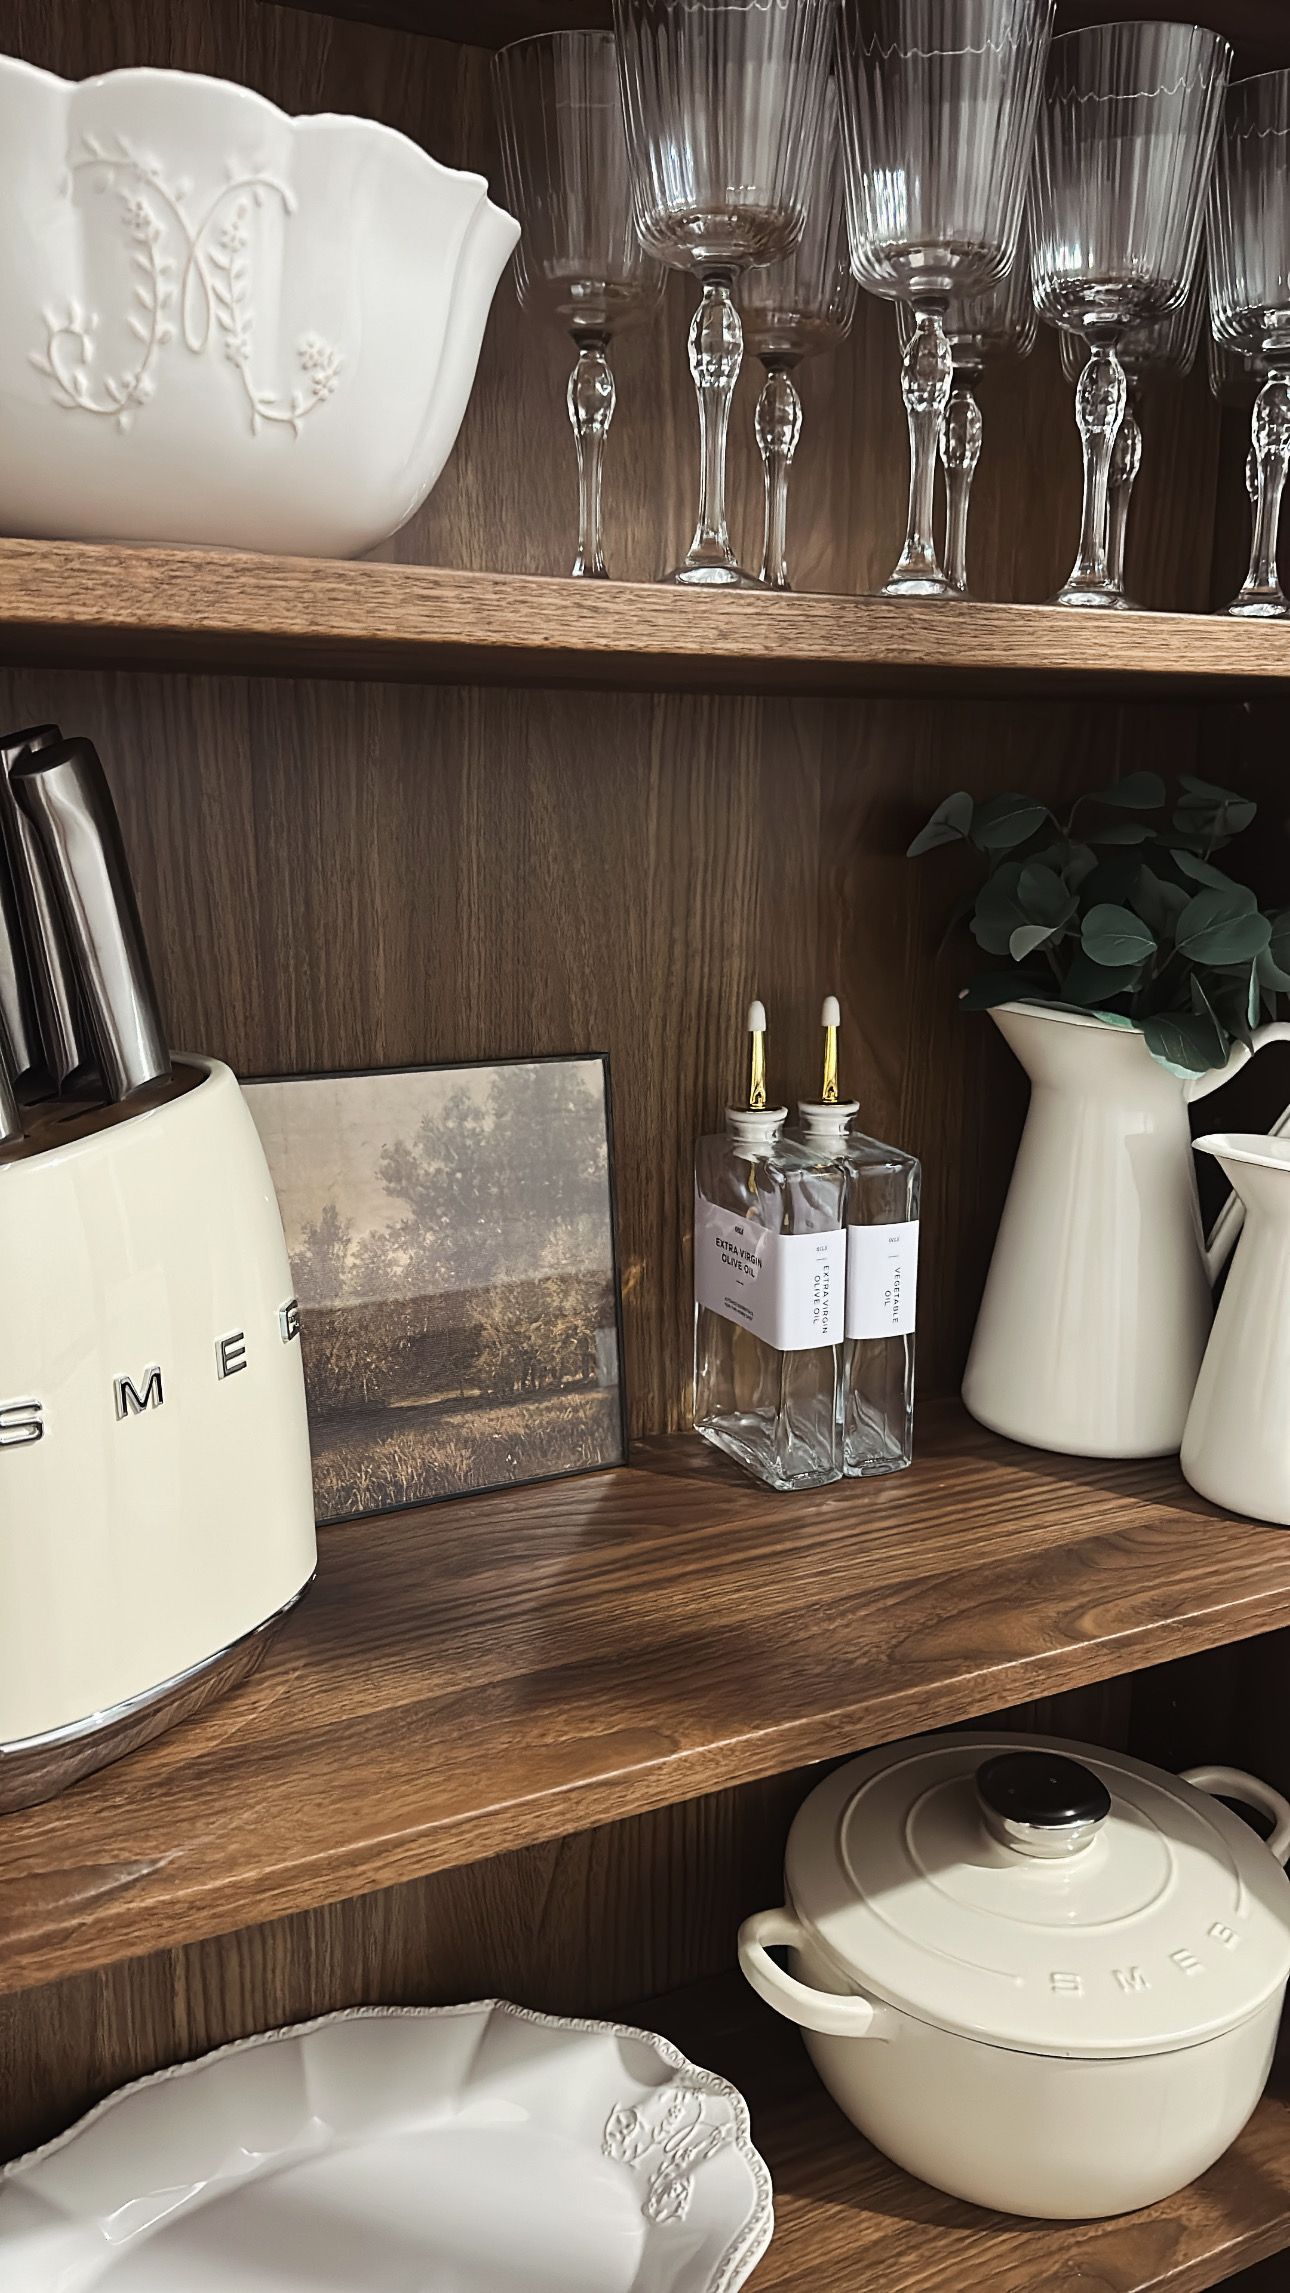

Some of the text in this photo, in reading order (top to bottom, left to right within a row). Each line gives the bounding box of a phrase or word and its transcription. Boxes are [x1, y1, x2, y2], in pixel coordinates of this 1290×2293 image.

[715, 1237, 762, 1269] EXTRA VIRGIN
[721, 1253, 755, 1278] OLIVE OIL
[892, 1267, 901, 1324] VEGETABLE
[1050, 1921, 1241, 1997] SMEG
